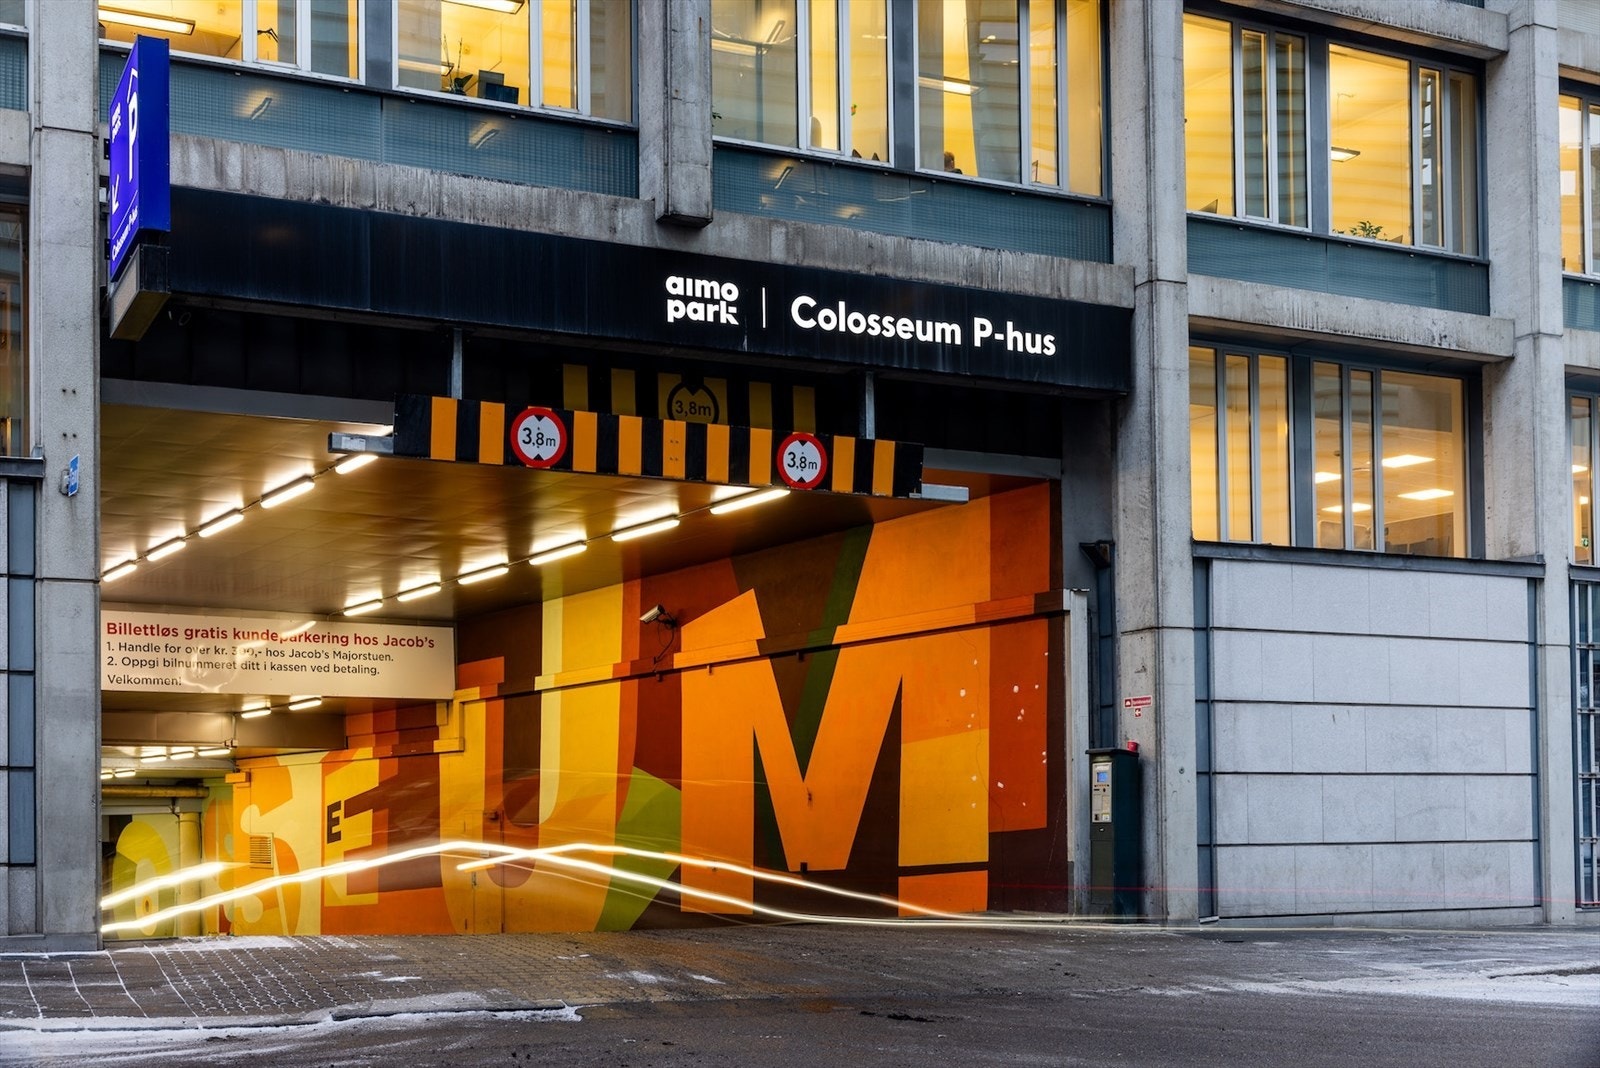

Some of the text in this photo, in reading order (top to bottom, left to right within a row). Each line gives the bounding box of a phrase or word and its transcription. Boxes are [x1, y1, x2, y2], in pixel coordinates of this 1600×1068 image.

[128, 92, 138, 182] P
[665, 275, 739, 302] aimo
[666, 298, 739, 325] park
[790, 295, 1057, 356] Colosseum P-hus
[106, 622, 179, 637] Billettløs
[184, 627, 228, 640] gratis
[353, 633, 379, 646] hos
[383, 634, 435, 648] Jacob's
[106, 641, 114, 651] 1.
[118, 642, 161, 653] Handle
[164, 643, 181, 654] for
[214, 645, 228, 655] kr.
[265, 648, 285, 658] hos
[288, 649, 329, 659] Jacob's
[332, 650, 394, 662] Majorstuen.
[107, 656, 117, 666] 2.
[121, 657, 159, 669] Oppgi
[240, 660, 260, 671] ditt
[263, 661, 267, 671] i
[270, 662, 307, 672] kassen
[310, 663, 330, 673] ved
[333, 663, 380, 676] betaling.
